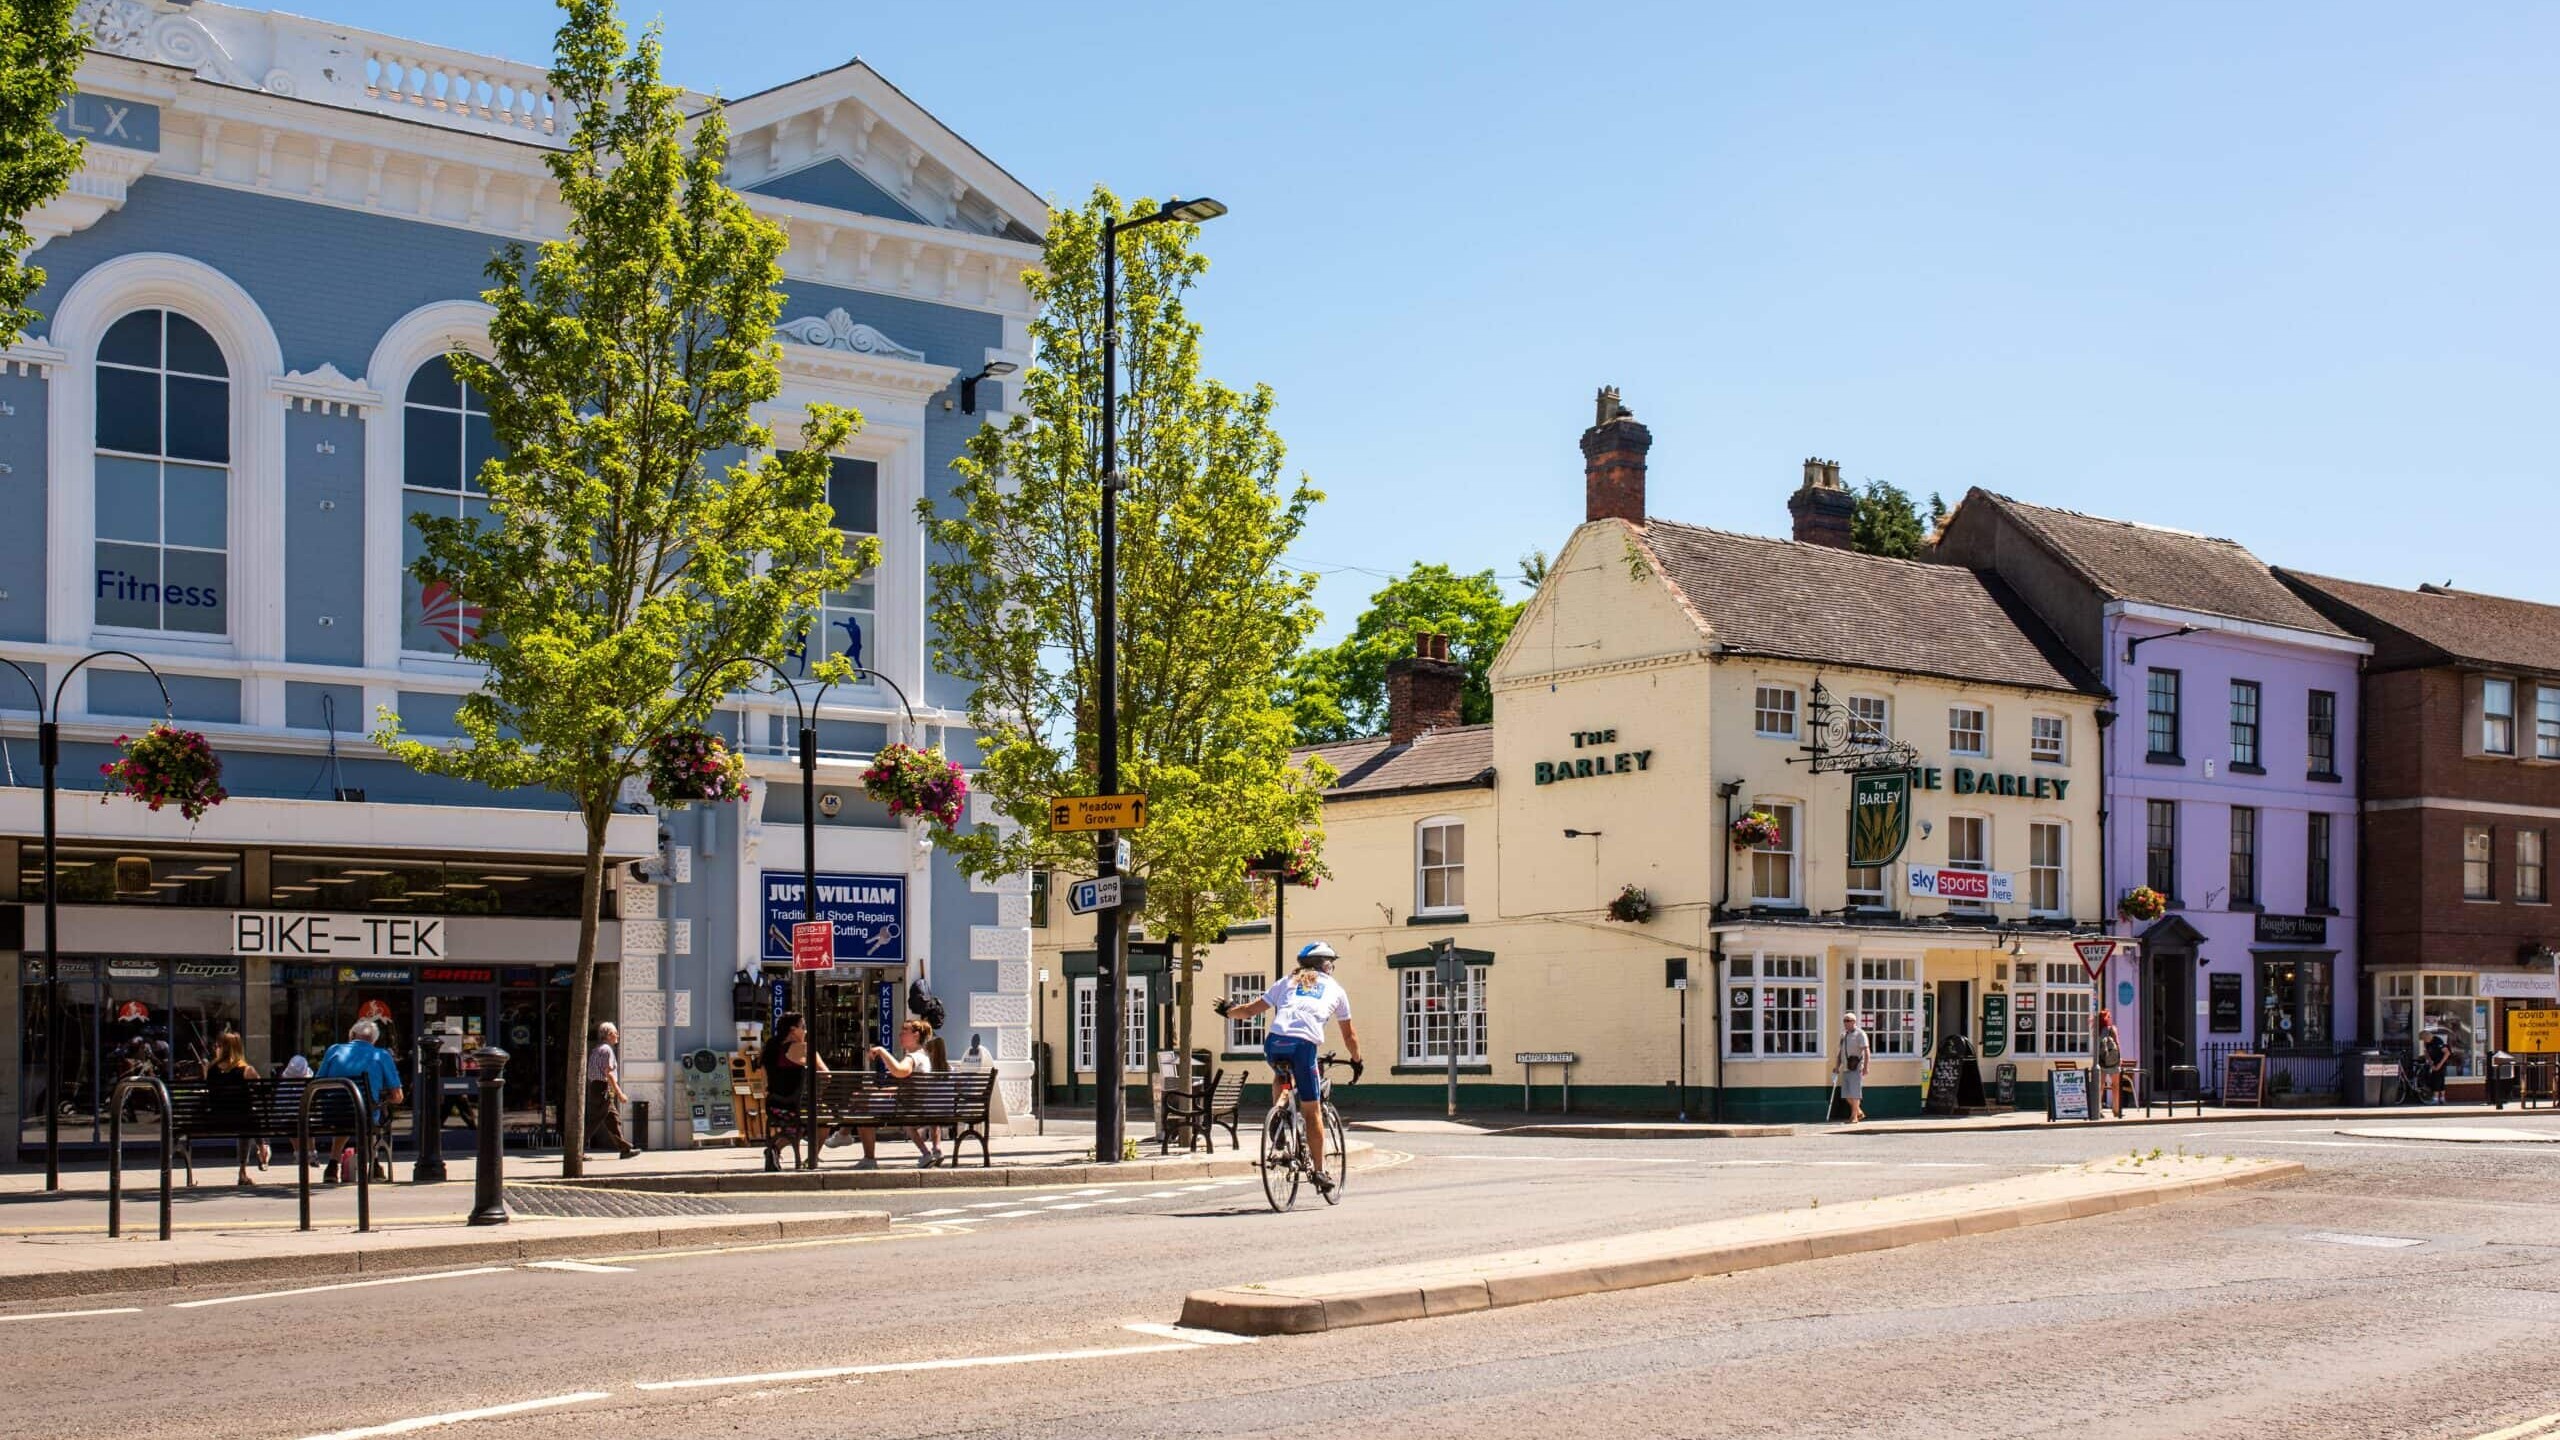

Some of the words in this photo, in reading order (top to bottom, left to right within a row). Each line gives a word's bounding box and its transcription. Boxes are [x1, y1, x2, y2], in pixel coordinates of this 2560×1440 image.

[97, 569, 217, 608] Fitness
[1570, 729, 1616, 749] THE
[1535, 749, 1652, 786] BARLEY
[1874, 781, 1888, 790] THE
[1911, 767, 1942, 789] HE
[1954, 767, 2070, 801] BARLEY
[1859, 790, 1901, 806] BARLEY
[1079, 801, 1122, 812] Meadow
[1084, 813, 1116, 825] Grove
[1098, 881, 1118, 893] Long
[1912, 869, 1936, 892] sky
[1939, 873, 1986, 894] sports
[1992, 874, 2007, 887] live
[816, 885, 896, 905] WILLIAM
[1100, 893, 1117, 905] stay
[1992, 888, 2012, 900] here
[827, 910, 854, 922] Shoe
[856, 912, 895, 924] Repairs
[833, 925, 868, 938] Cutting
[2260, 916, 2297, 935] Boughey
[2298, 918, 2323, 932] House
[238, 915, 439, 957] BIKE-TEK
[2083, 946, 2107, 955] GIVE
[177, 963, 239, 977] hope
[360, 971, 409, 979] MICHELIN
[882, 986, 890, 1020] KEY
[2517, 1011, 2545, 1019] COVID
[1519, 1053, 1548, 1061] STAFFORD
[1549, 1053, 1571, 1061] STREET
